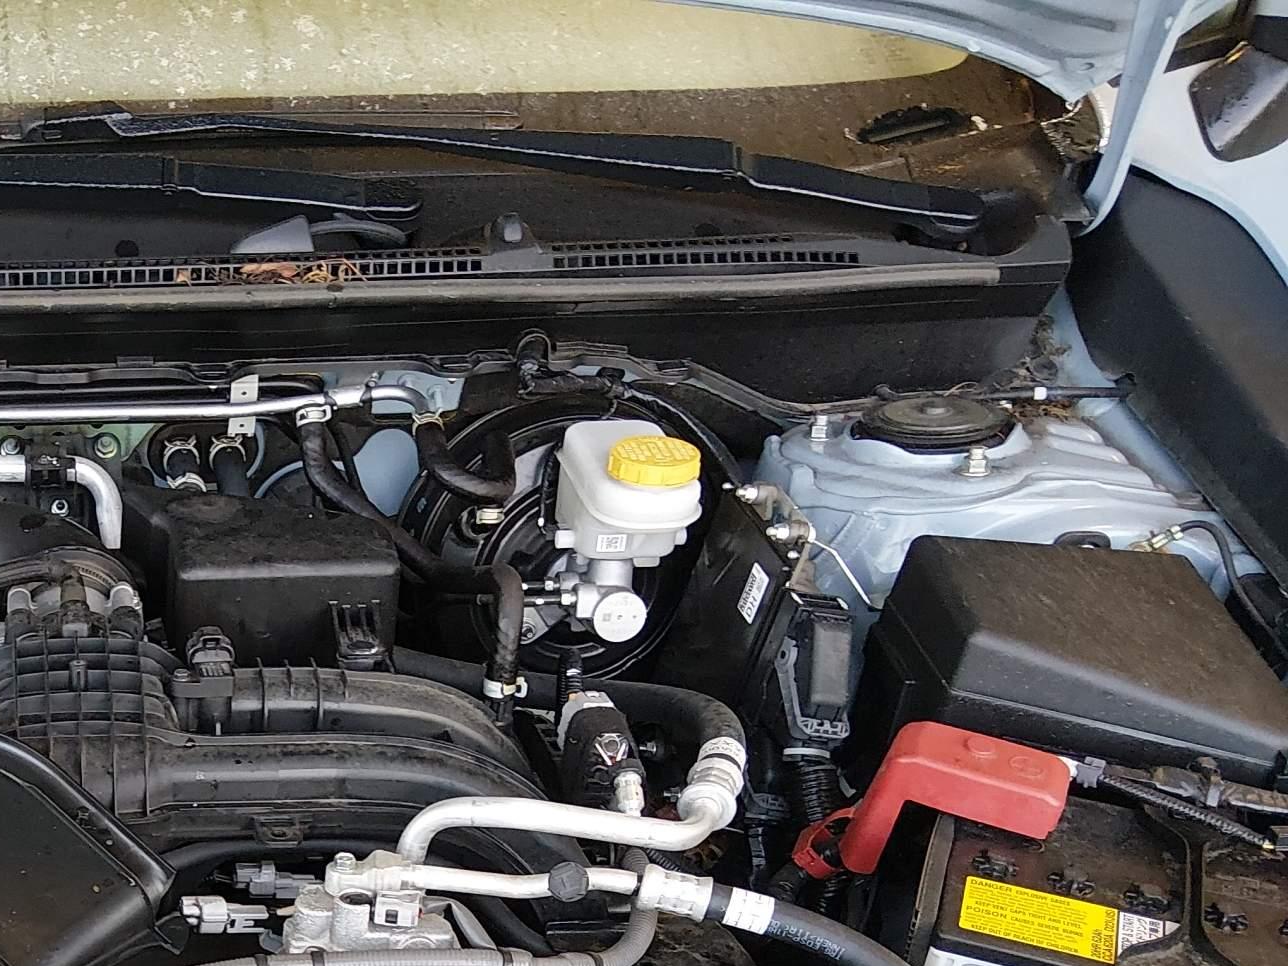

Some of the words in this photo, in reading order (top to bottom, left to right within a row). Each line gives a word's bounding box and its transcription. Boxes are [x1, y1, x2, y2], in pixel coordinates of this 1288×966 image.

[970, 879, 1012, 893] DANGER
[966, 905, 1008, 919] POISON
[1013, 934, 1034, 942] REACH
